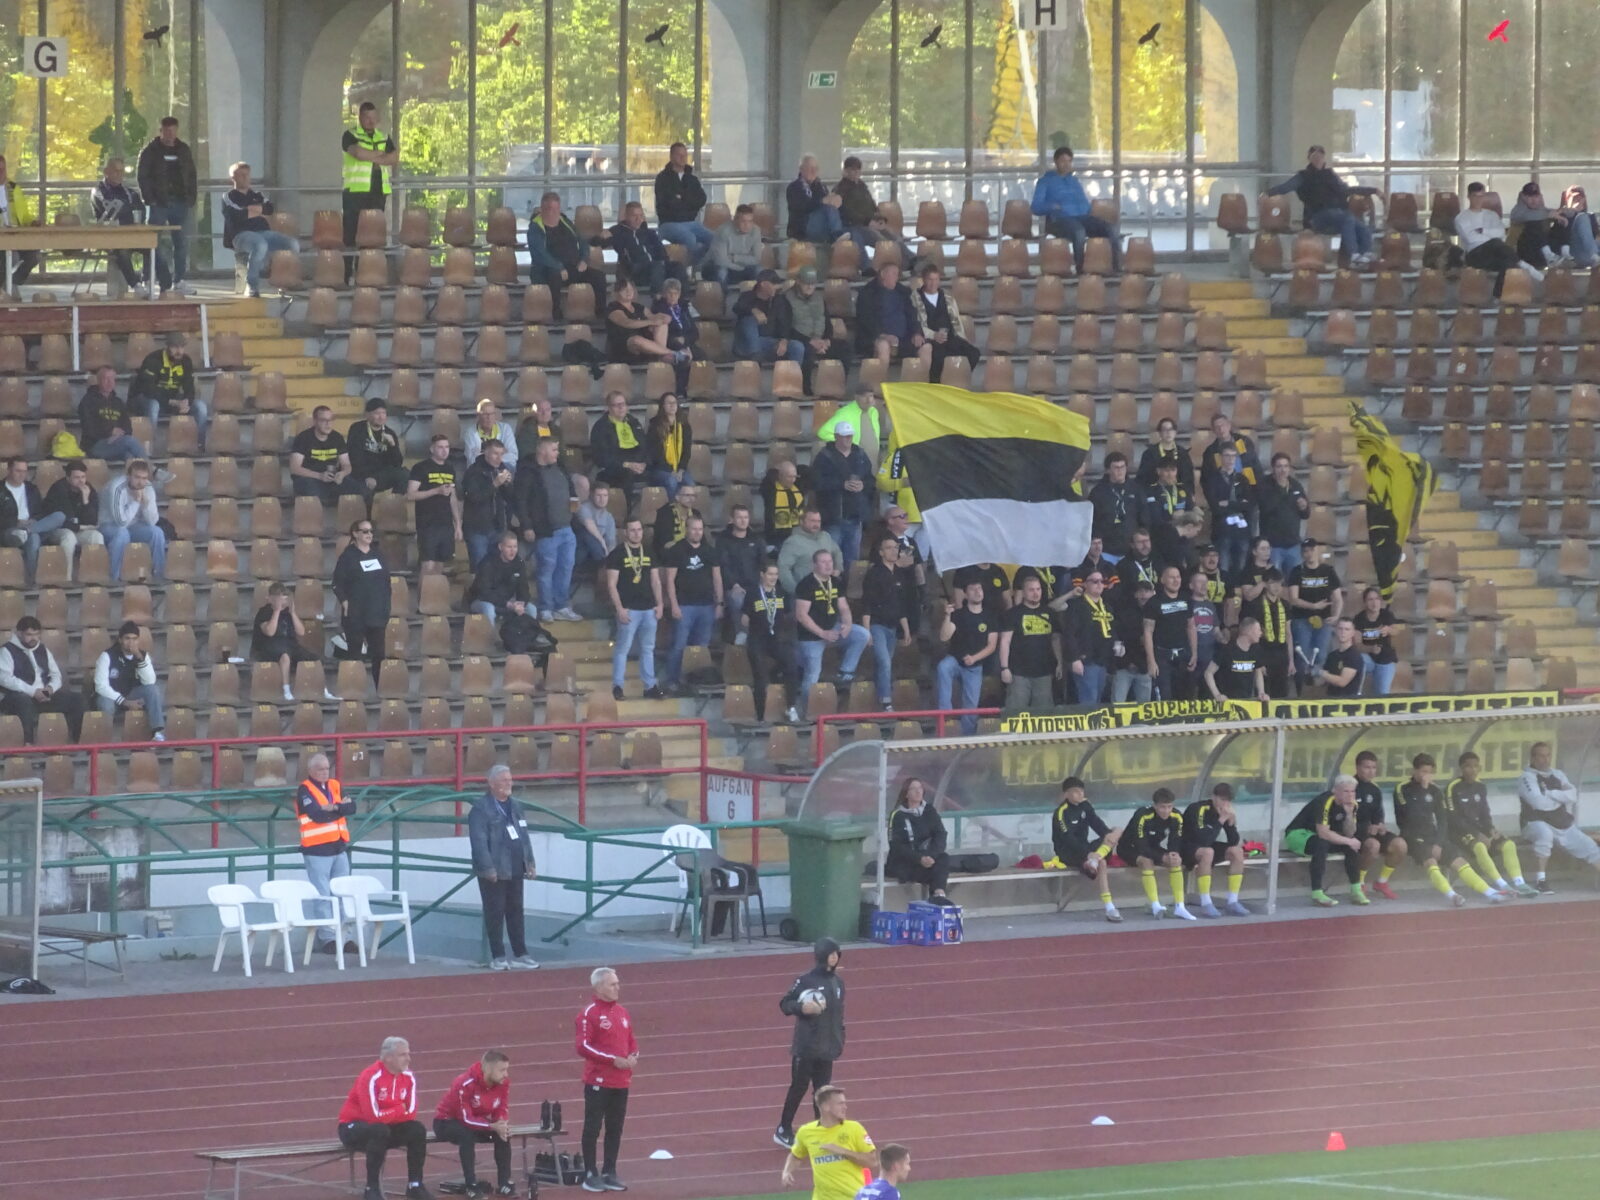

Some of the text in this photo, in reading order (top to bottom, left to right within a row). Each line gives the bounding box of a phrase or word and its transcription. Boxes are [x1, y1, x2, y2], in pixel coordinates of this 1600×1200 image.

[1035, 0, 1055, 25] H
[34, 41, 57, 72] G
[1143, 699, 1224, 721] SUPCREW
